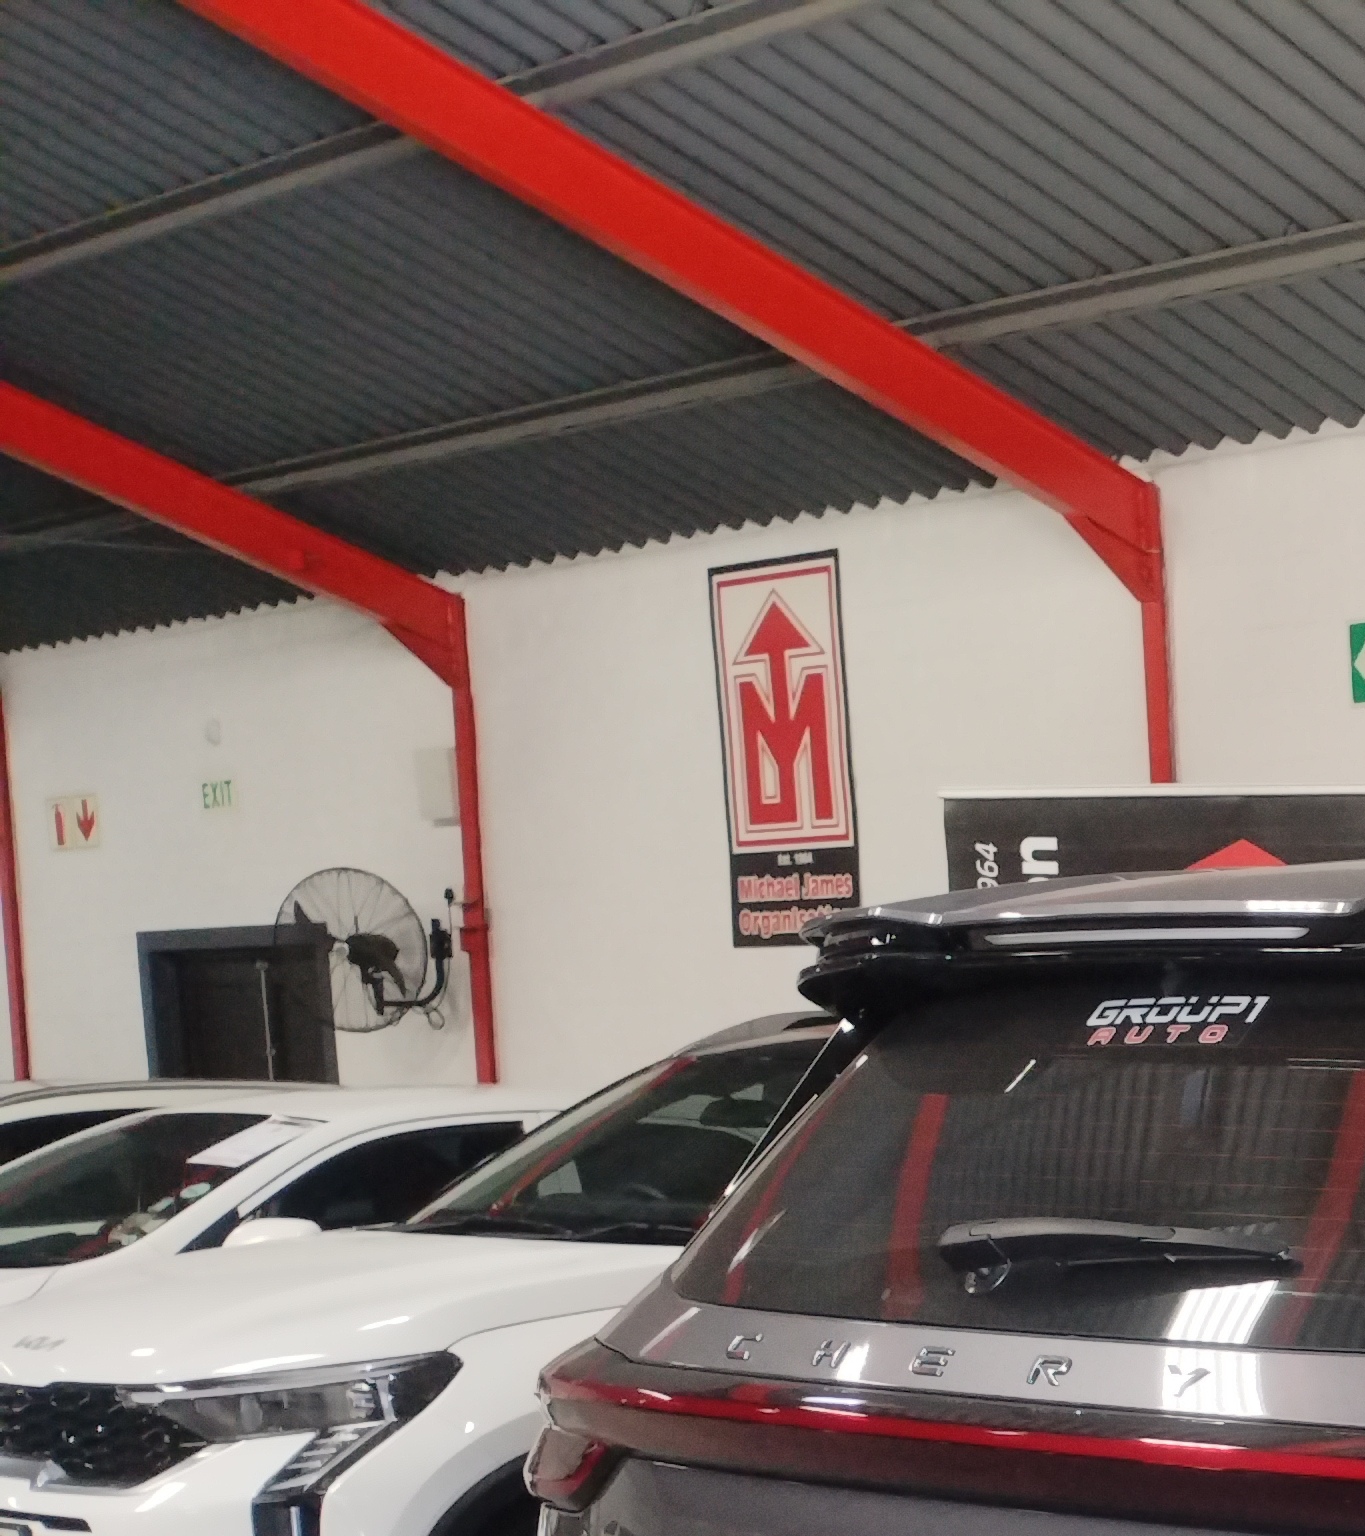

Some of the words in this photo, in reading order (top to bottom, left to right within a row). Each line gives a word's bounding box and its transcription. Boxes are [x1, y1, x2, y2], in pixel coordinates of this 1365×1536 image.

[202, 780, 232, 809] EXIT
[737, 872, 801, 903] Michael
[801, 871, 853, 900] James
[739, 904, 842, 939] Organis
[1086, 1024, 1229, 1047] AUTO
[725, 1333, 1212, 1398] CHERY
